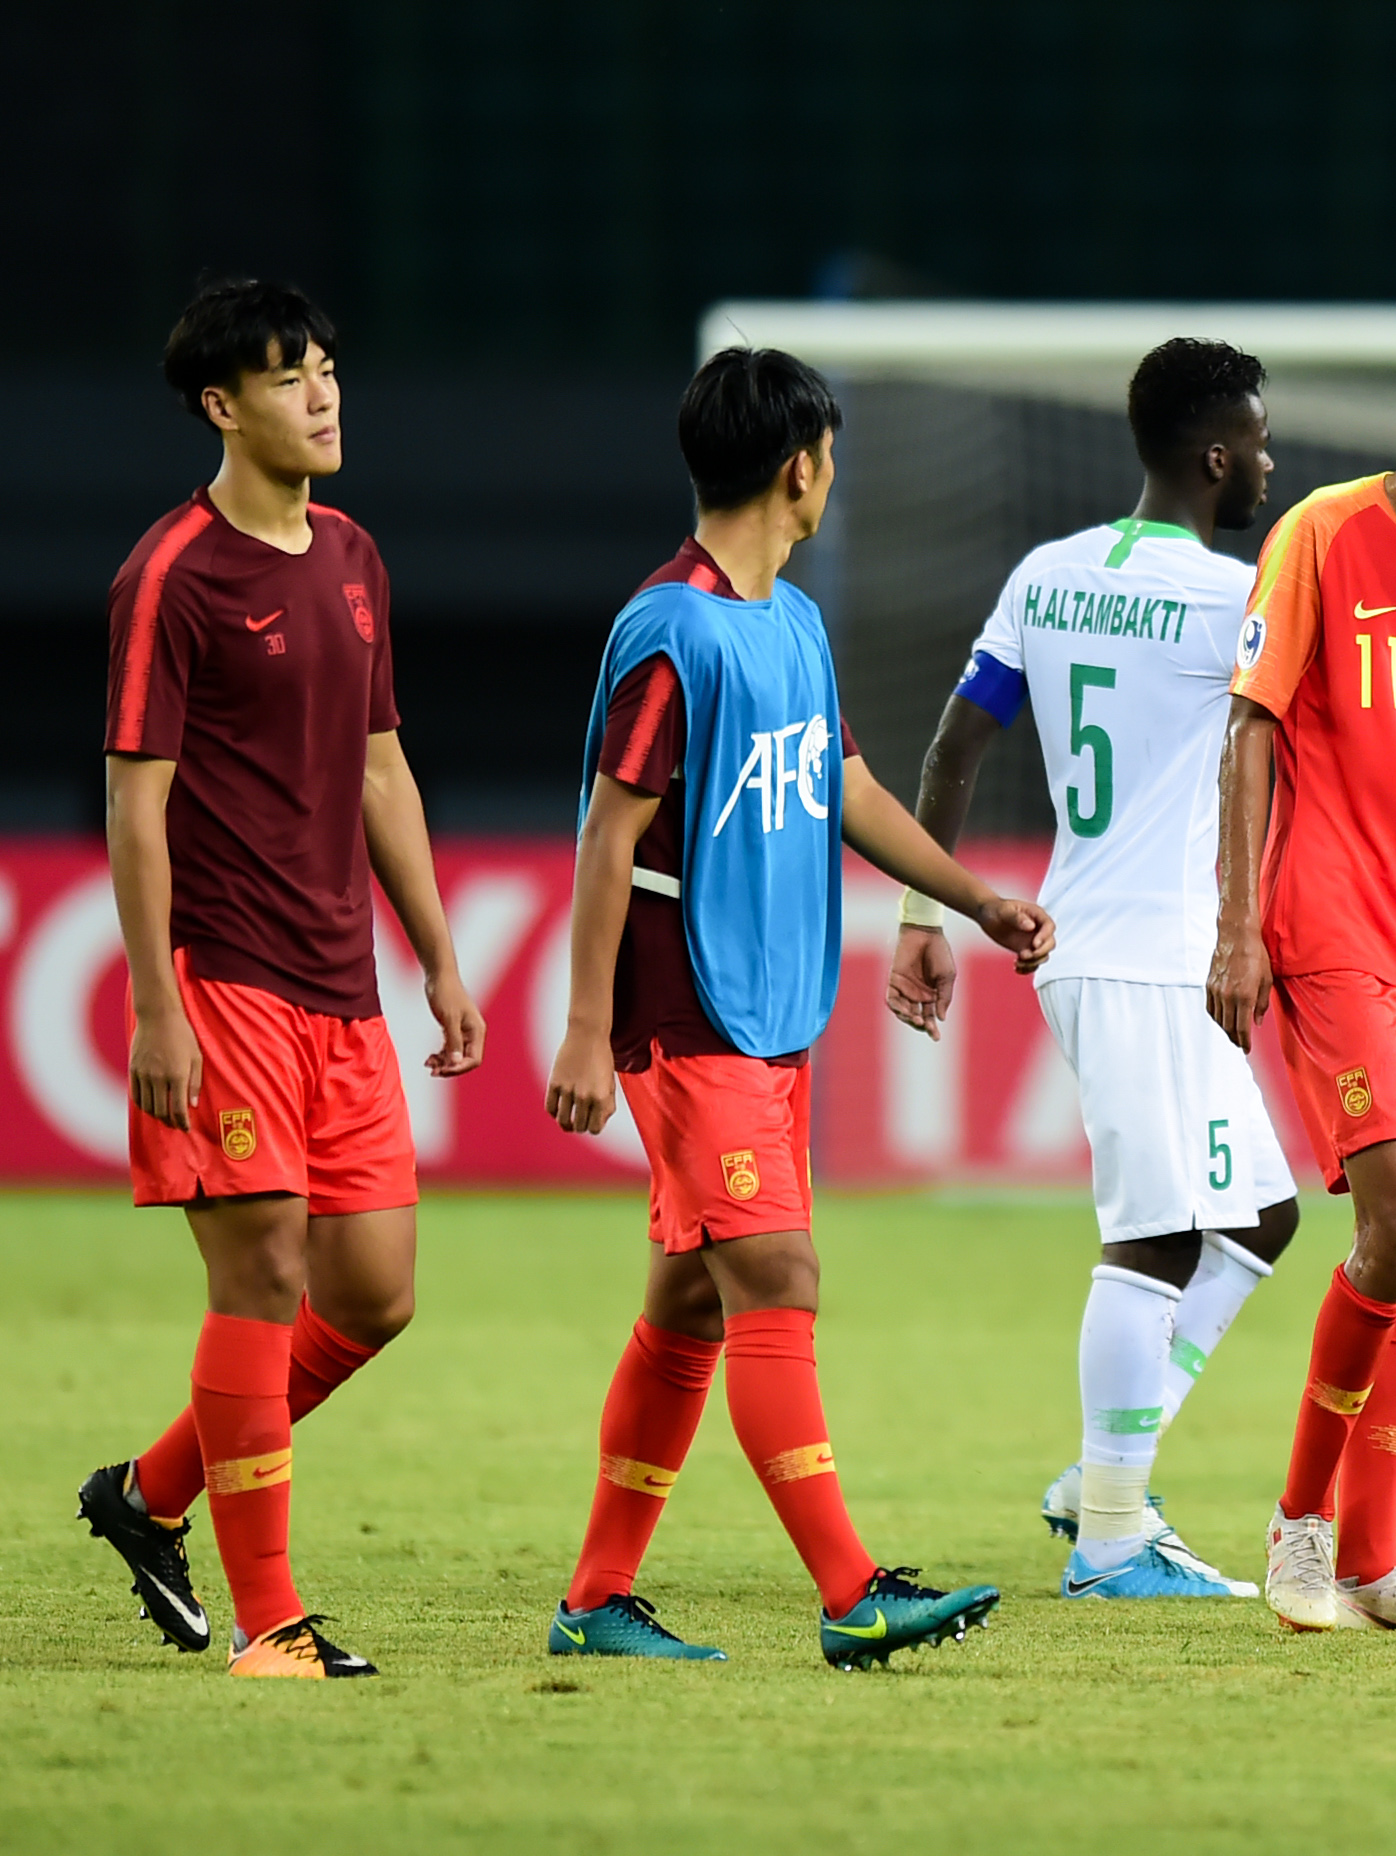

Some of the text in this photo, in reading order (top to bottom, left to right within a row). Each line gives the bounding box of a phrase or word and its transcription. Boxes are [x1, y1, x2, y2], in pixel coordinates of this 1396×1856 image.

[1024, 585, 1187, 643] H.ALTAMBAKTI
[265, 633, 286, 655] 30
[1066, 662, 1117, 839] 5
[712, 714, 833, 838] AFC
[1339, 1070, 1364, 1087] CFA
[223, 1113, 252, 1125] CFA
[725, 1153, 752, 1167] CFA
[1208, 1119, 1232, 1191] 5
